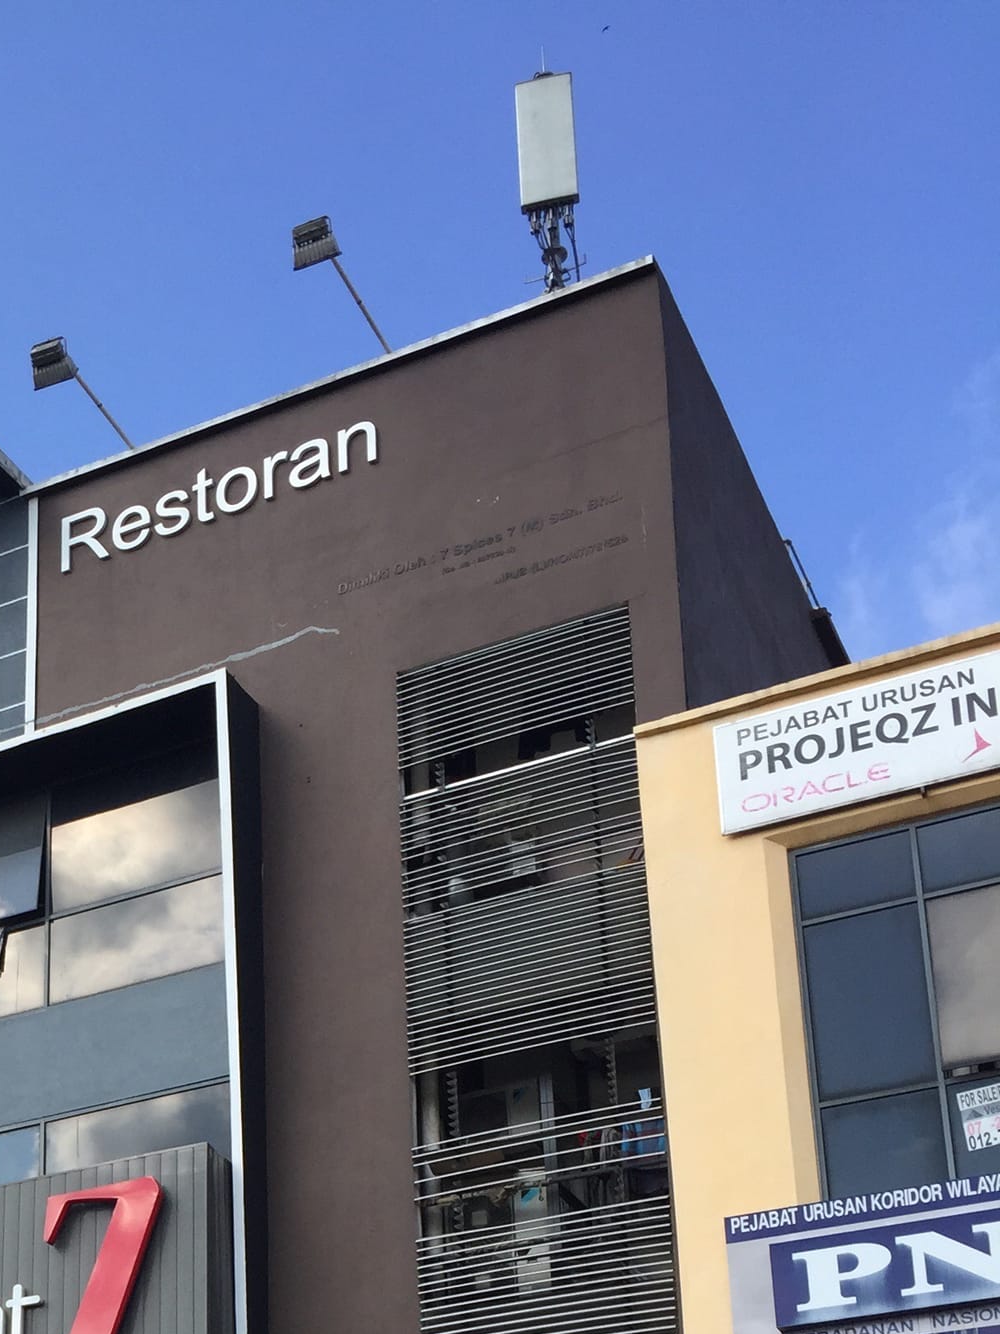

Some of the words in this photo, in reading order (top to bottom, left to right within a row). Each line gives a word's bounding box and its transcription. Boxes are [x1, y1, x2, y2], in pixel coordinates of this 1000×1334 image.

[59, 418, 380, 575] Restoran
[736, 700, 853, 747] PEJABAT
[862, 667, 976, 712] URUSAN
[738, 702, 940, 781] PROJEQZ
[741, 762, 891, 813] ORACLE
[960, 1092, 977, 1109] FOR
[976, 1086, 998, 1104] SALE
[731, 1207, 799, 1235] PEJABAT
[804, 1195, 868, 1223] URUSAN
[871, 1183, 943, 1213] KORIDOR
